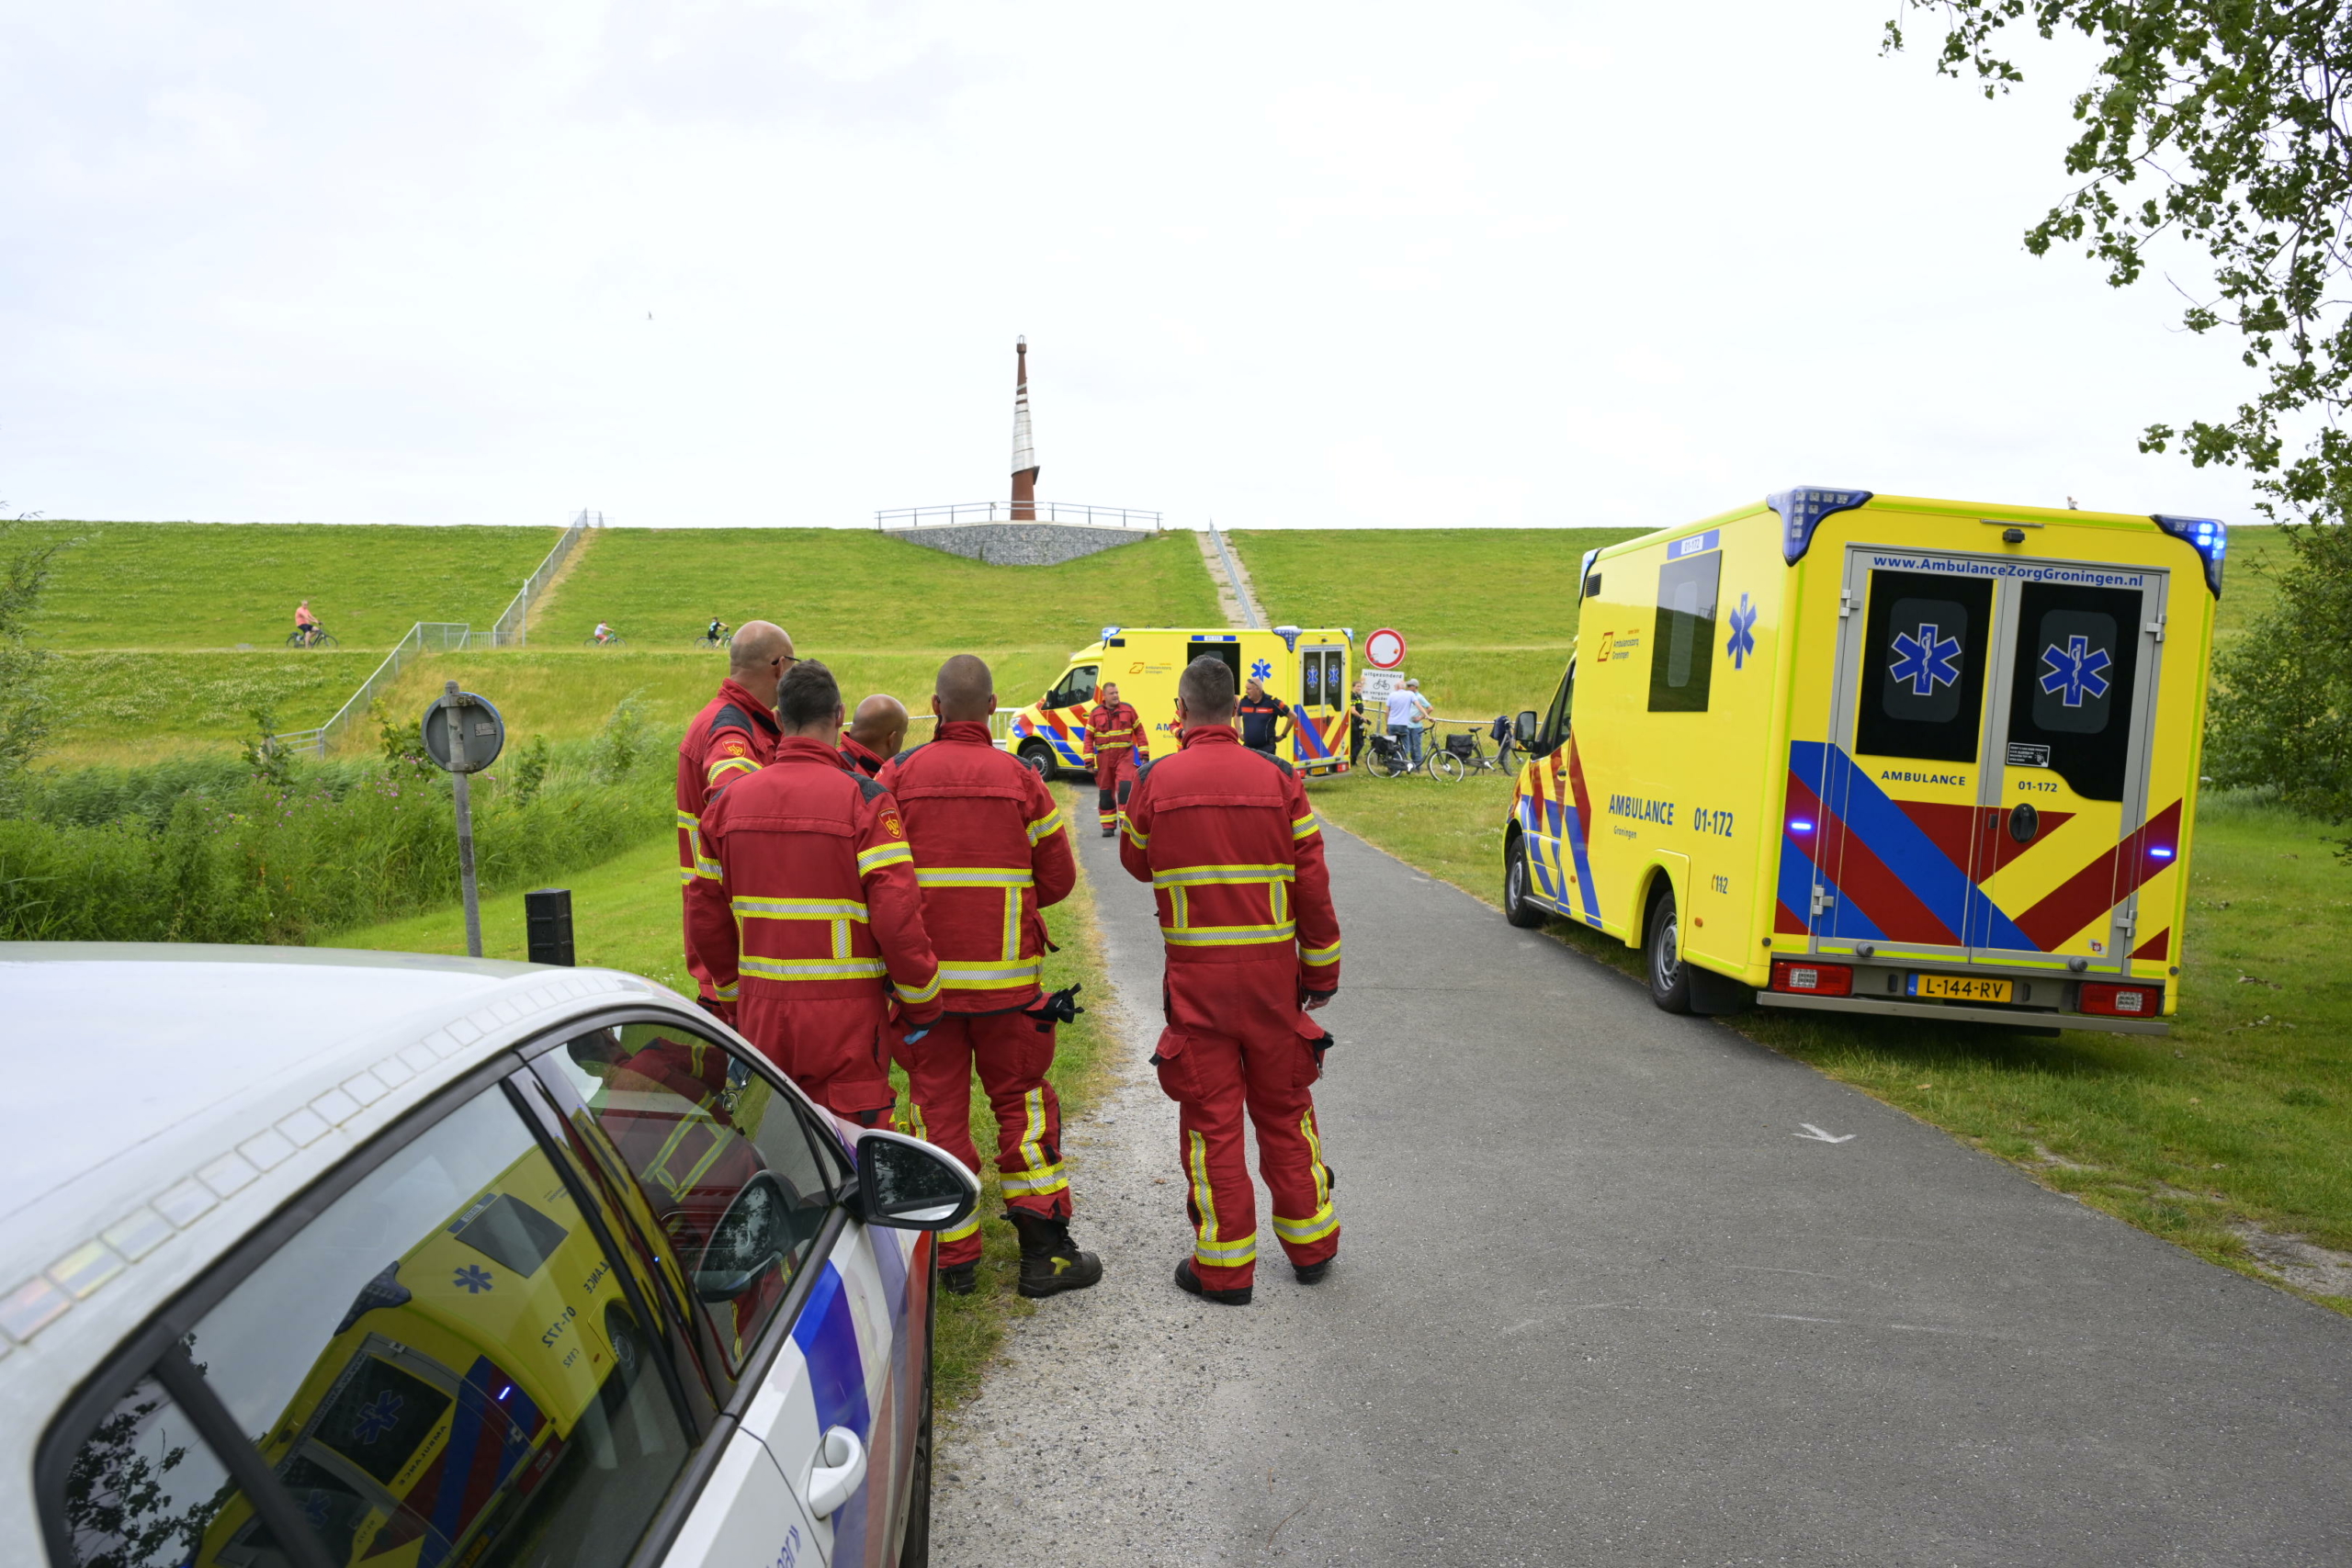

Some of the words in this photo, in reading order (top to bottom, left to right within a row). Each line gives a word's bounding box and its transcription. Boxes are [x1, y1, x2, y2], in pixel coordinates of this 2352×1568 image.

[1684, 538, 1701, 552] 01-172
[1873, 556, 2143, 587] www.AmbulanceZorgGroningen.nl
[1881, 770, 1966, 786] AMBULANCE
[2018, 781, 2058, 793] 01-172
[1608, 794, 1674, 826] AMBULANCE
[1694, 807, 1734, 838] 01-172
[1613, 826, 1637, 840] Groningen
[1927, 978, 2003, 998] L-144-RV
